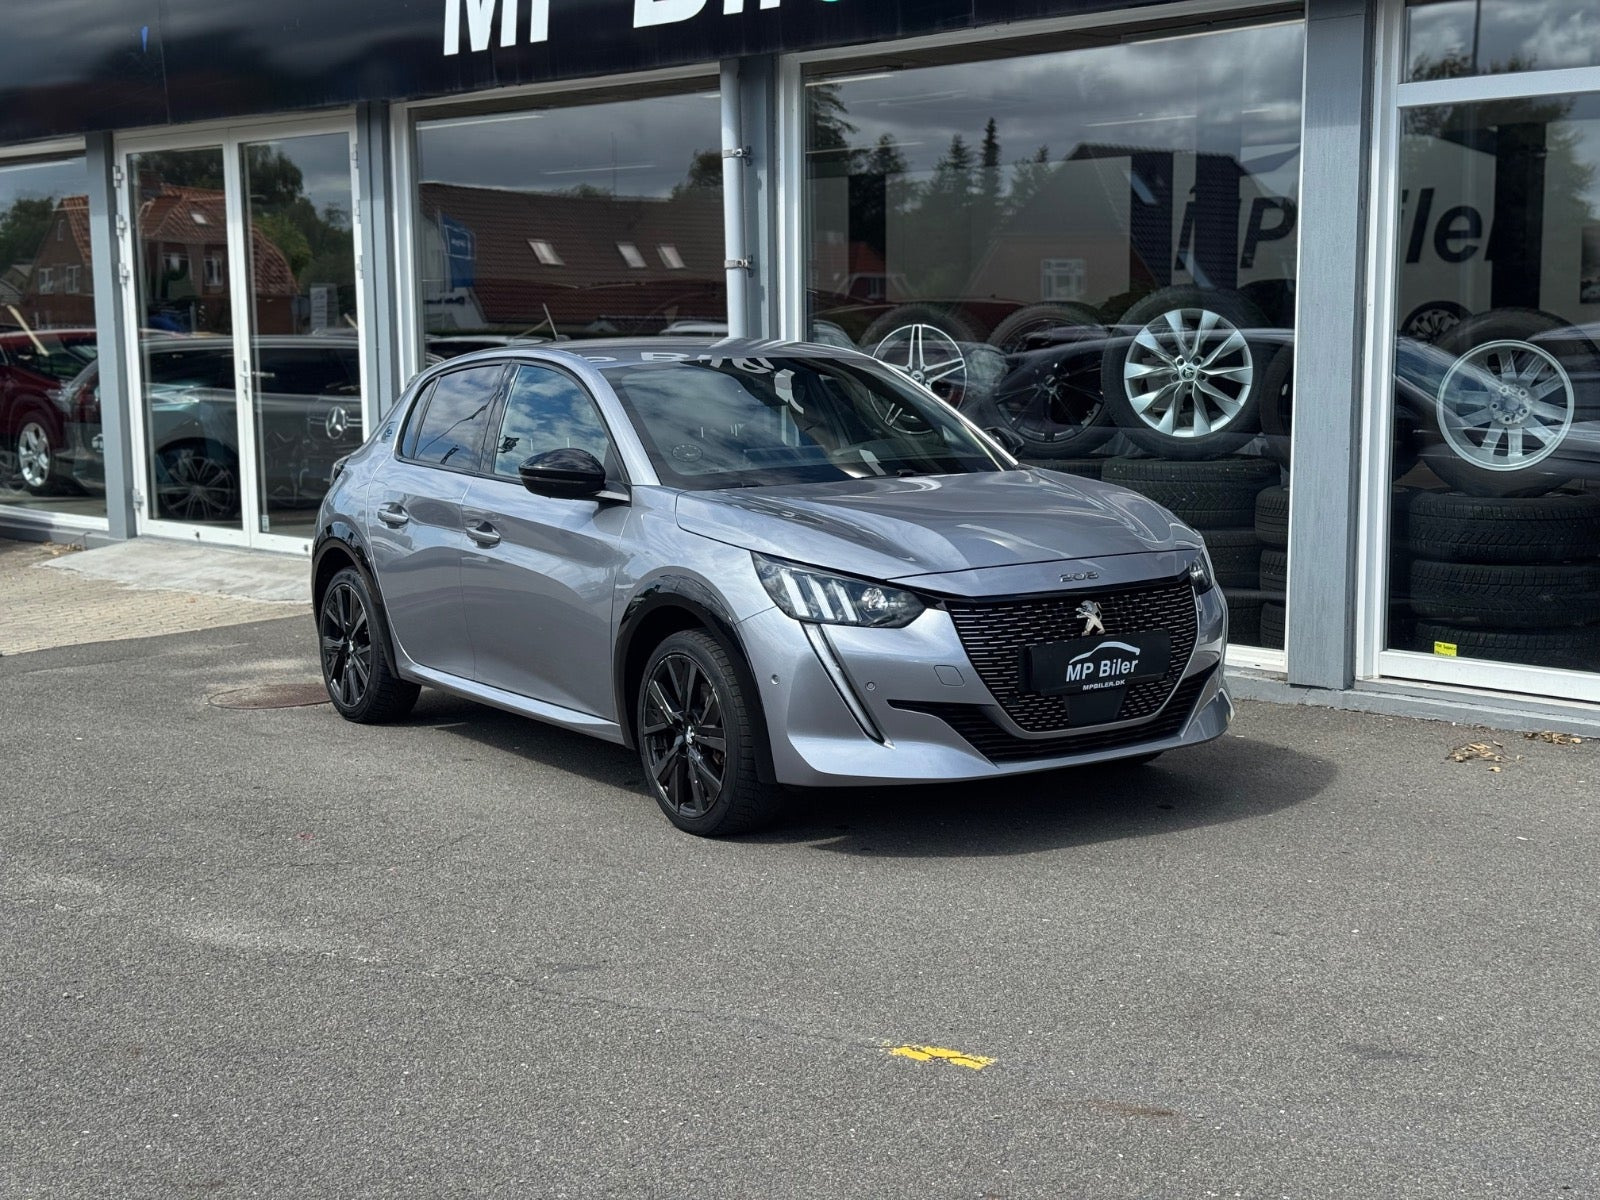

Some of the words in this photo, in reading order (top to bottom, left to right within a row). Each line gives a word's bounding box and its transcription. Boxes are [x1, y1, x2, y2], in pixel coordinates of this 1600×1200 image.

[1066, 663, 1094, 682] MP
[1099, 659, 1138, 677] Biler
[1083, 679, 1125, 691] MPBILER.DK
